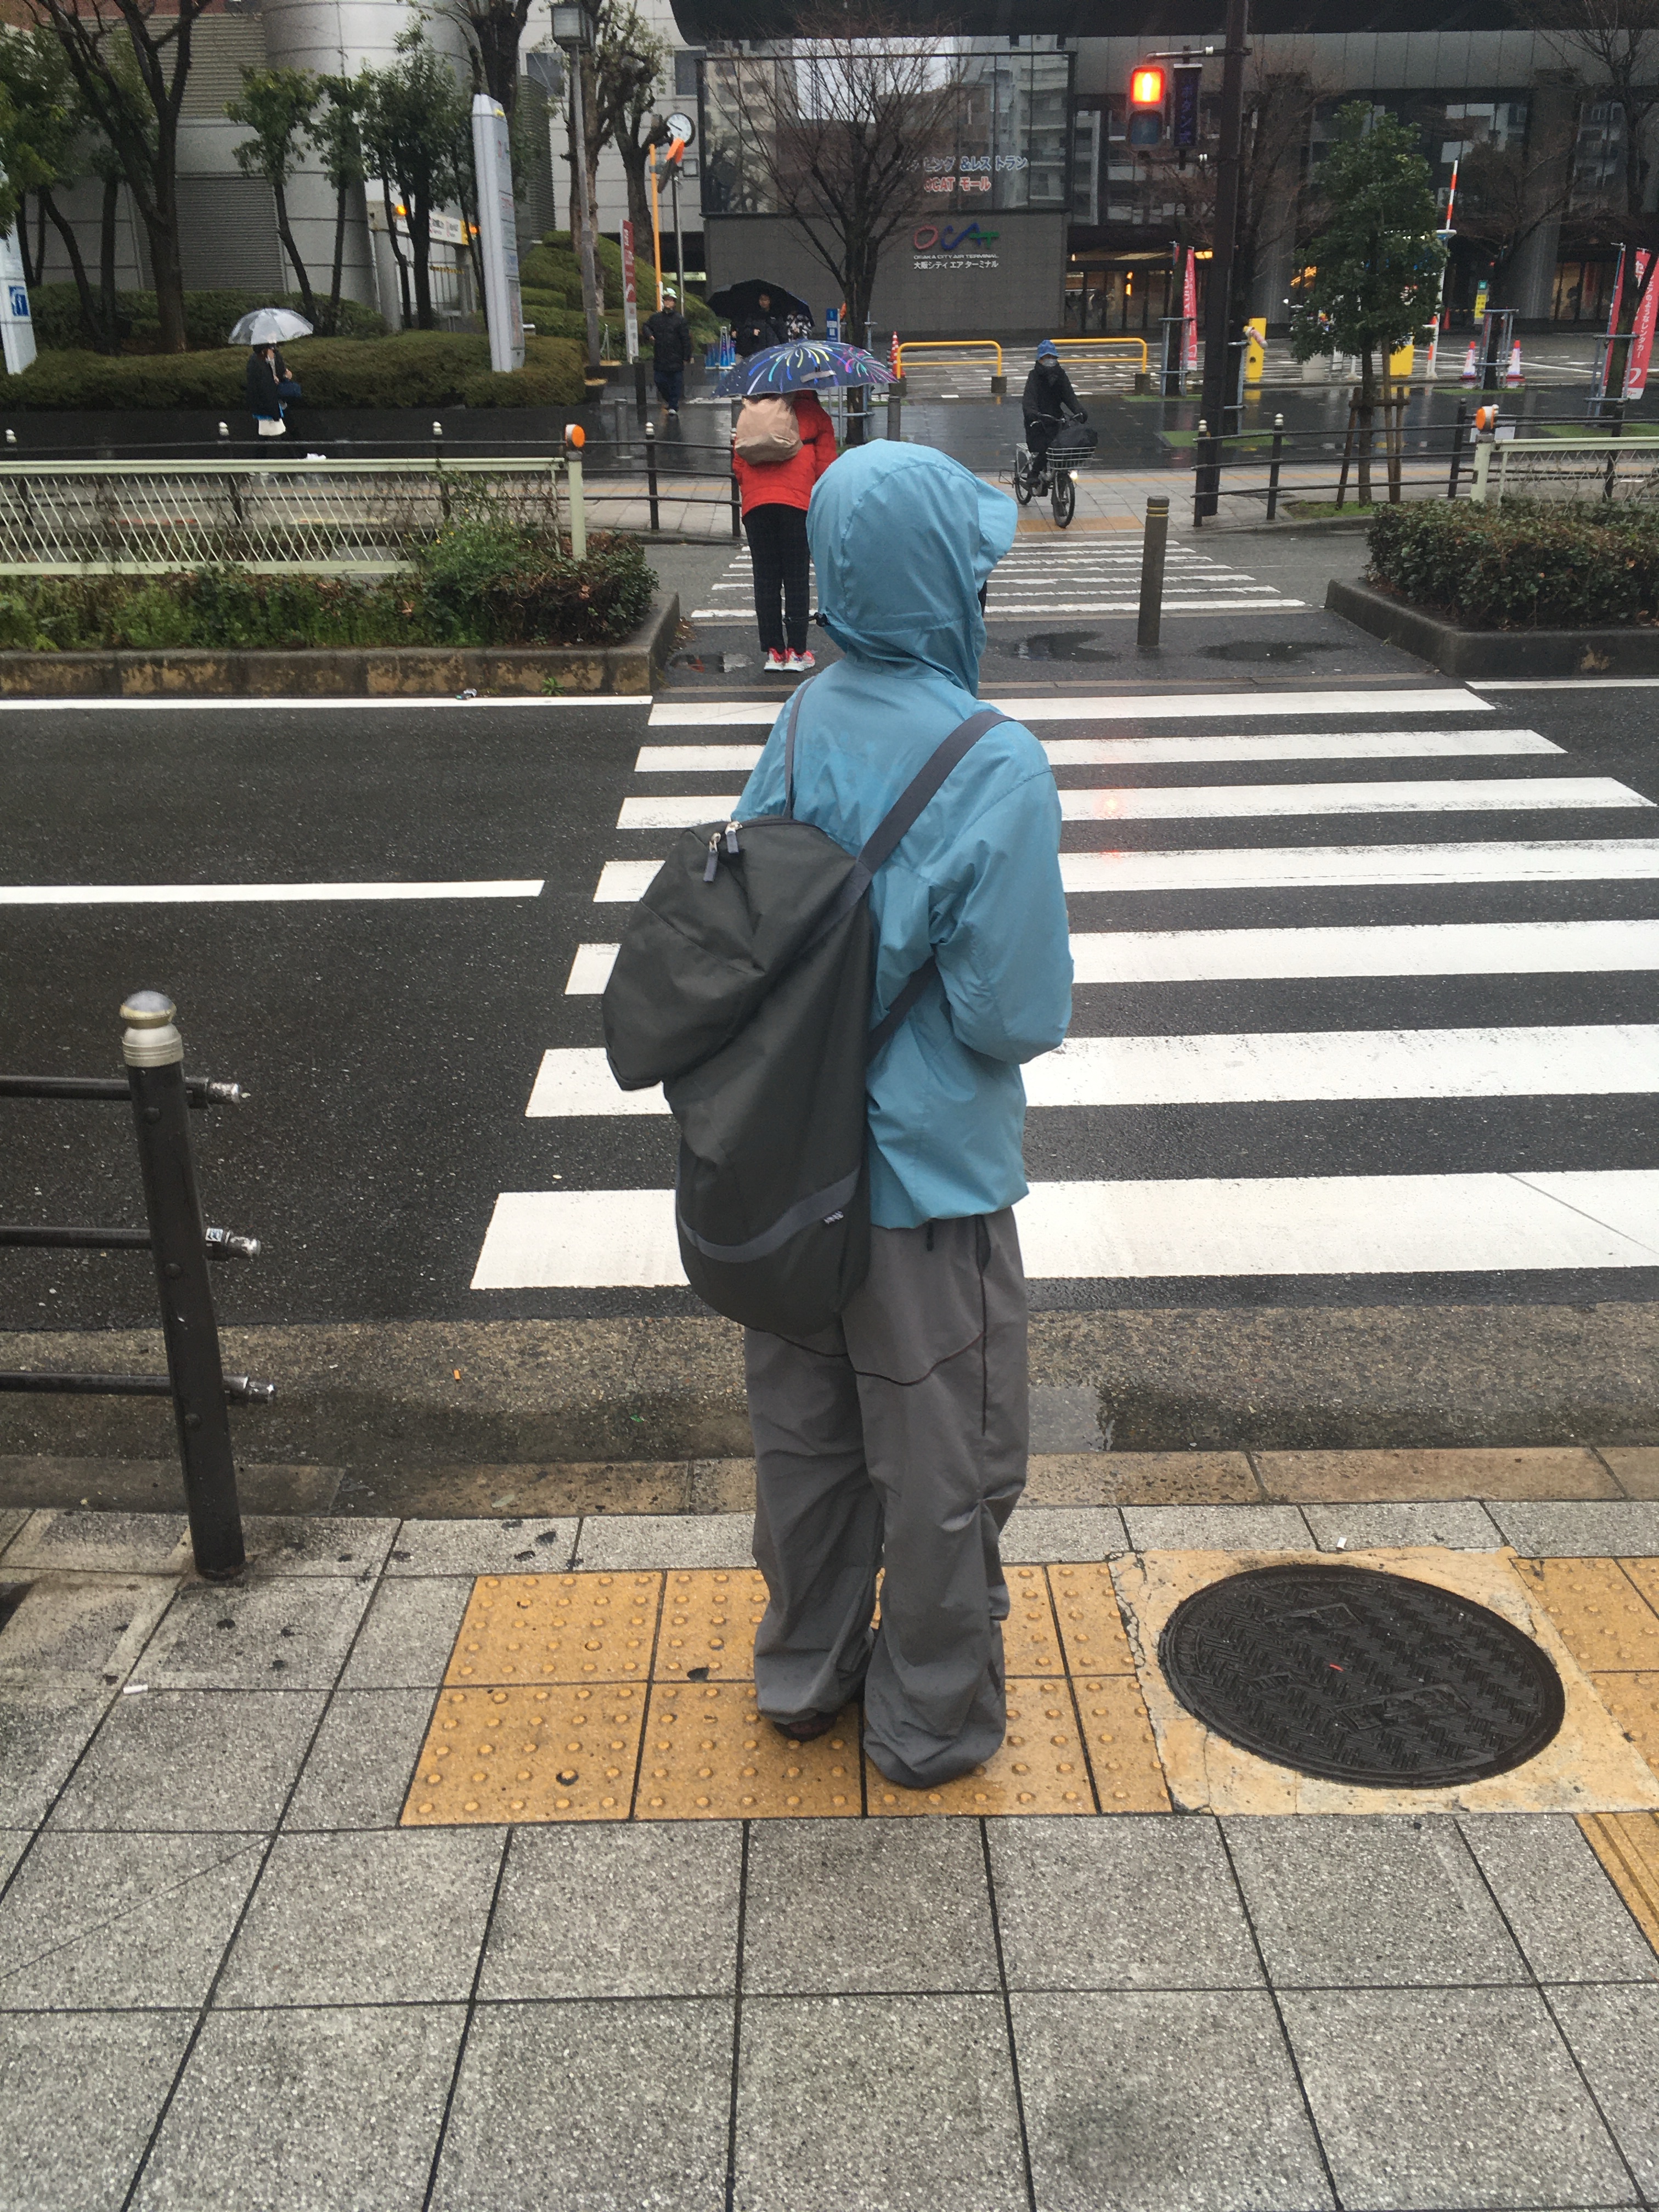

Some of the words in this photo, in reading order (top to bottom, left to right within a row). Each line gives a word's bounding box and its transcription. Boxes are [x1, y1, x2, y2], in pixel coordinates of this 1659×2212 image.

[924, 177, 956, 192] OCAT
[960, 176, 991, 191] モール
